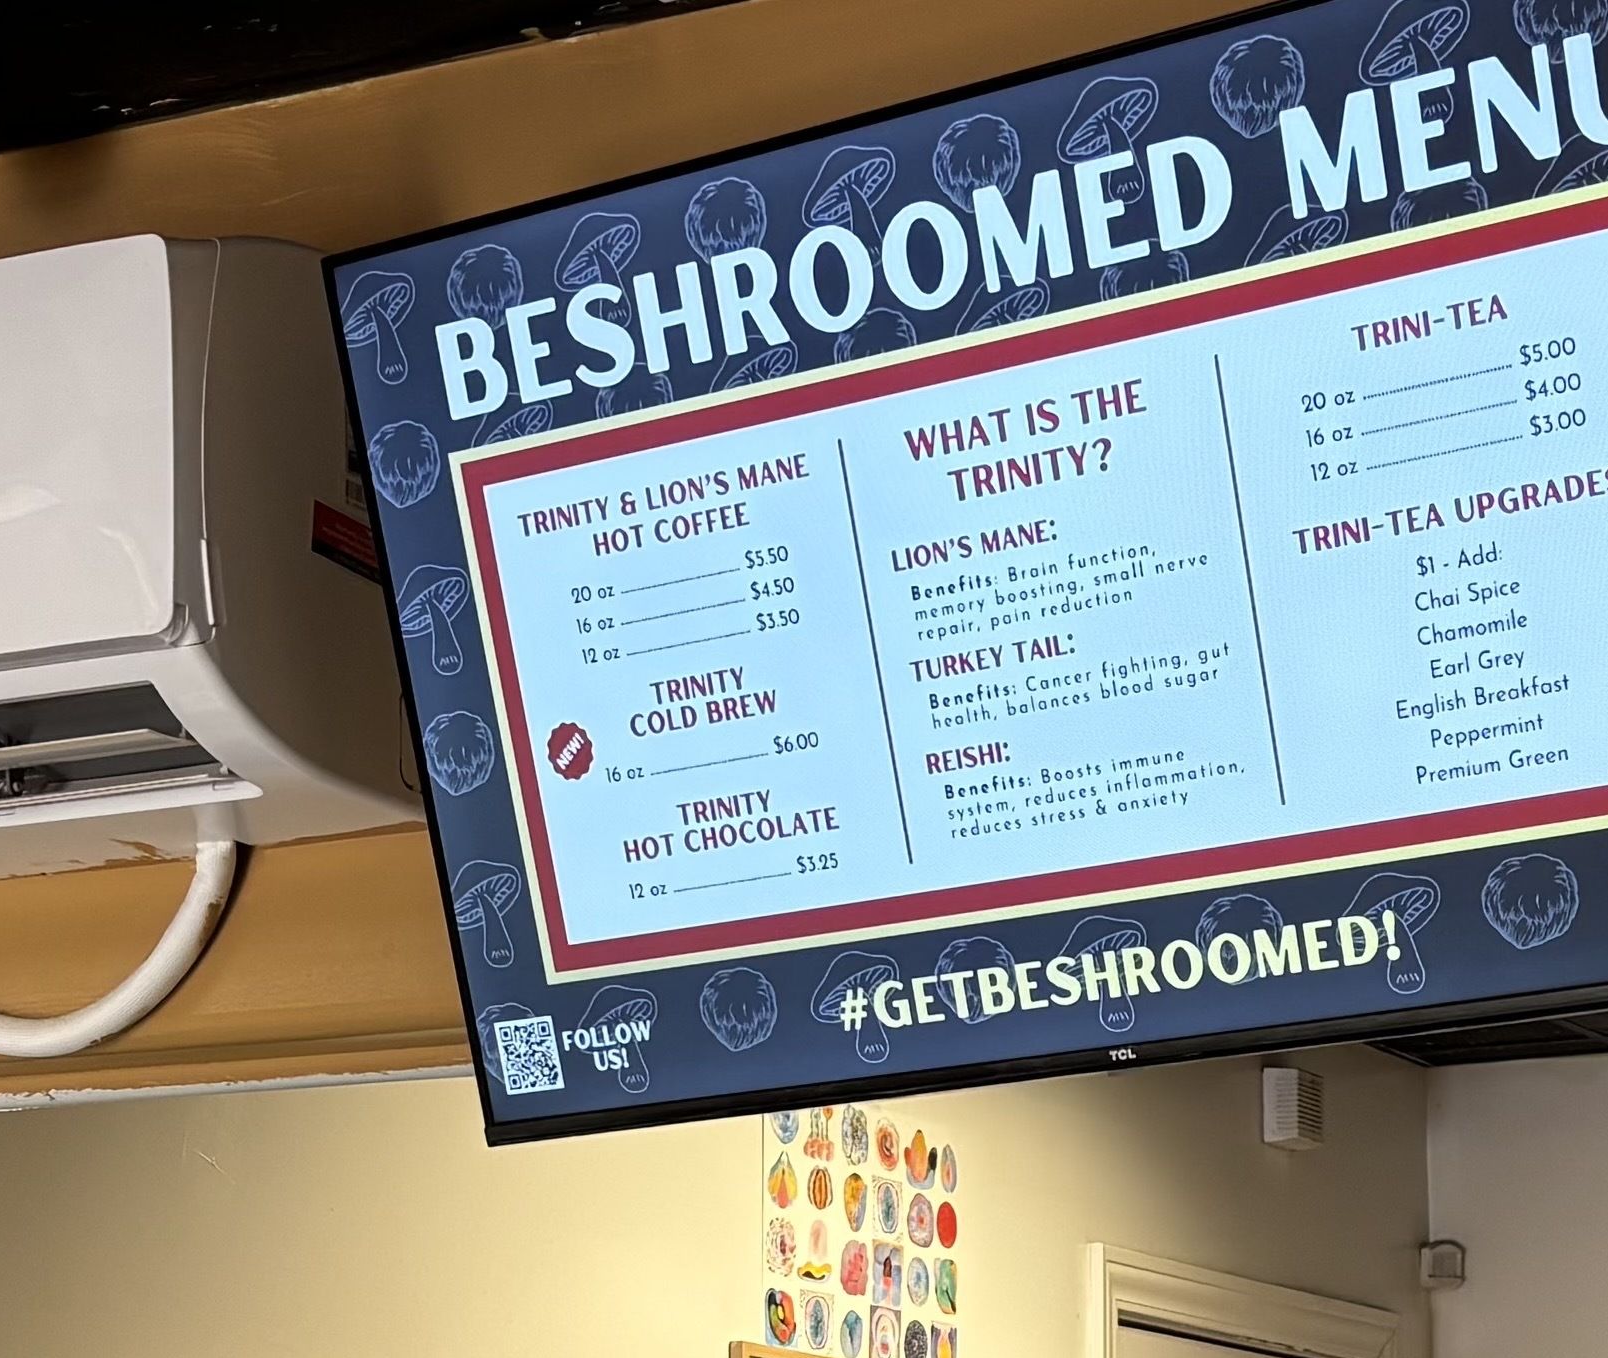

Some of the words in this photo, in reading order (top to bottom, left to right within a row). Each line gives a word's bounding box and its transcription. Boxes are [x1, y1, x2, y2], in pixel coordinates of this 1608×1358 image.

[434, 135, 1234, 422] BESHROOMED
[1350, 294, 1508, 351] TRINI-TEA
[1301, 391, 1327, 413] 20
[1334, 391, 1356, 406] oz
[1519, 336, 1576, 366] $5.00
[903, 408, 1011, 462] WHAT
[1025, 398, 1060, 436] IS
[1070, 378, 1147, 425] THE
[1305, 427, 1325, 448] 16
[1332, 426, 1354, 442] oz
[1524, 372, 1581, 402] $4.00
[947, 437, 1112, 501] TRINITY?
[1310, 461, 1331, 482] 12
[1337, 461, 1359, 477] oz
[1529, 408, 1586, 437] $3.00
[517, 495, 608, 537] TRINITY
[619, 491, 637, 516] &
[645, 470, 730, 511] LION'S
[736, 453, 810, 491] MANE
[592, 524, 644, 557] HOT
[654, 501, 750, 543] COFFEE
[891, 535, 973, 572] LION'S
[980, 519, 1057, 555] MANE:
[1291, 503, 1445, 555] TRINI-TEA
[570, 585, 592, 604] 20
[597, 585, 615, 599] oz
[744, 545, 789, 570] $5.50
[910, 574, 997, 601] Benefits:
[1007, 563, 1058, 582] Brain
[1068, 545, 1156, 569] function,
[1416, 555, 1435, 577] $1
[1457, 540, 1502, 569] Add:
[576, 617, 592, 634] 16
[597, 617, 615, 631] oz
[750, 576, 795, 601] $4.50
[915, 599, 985, 623] memory
[994, 581, 1084, 606] boosting,
[1093, 560, 1144, 586] small
[1155, 554, 1208, 575] nerve
[918, 619, 981, 641] repair,
[990, 610, 1031, 631] pain
[1040, 583, 1132, 618] reduction
[1414, 587, 1460, 611] Chai
[1467, 581, 1520, 605] Spice
[581, 647, 598, 665] 12
[603, 648, 621, 661] oz
[756, 608, 800, 632] $3.50
[1417, 608, 1528, 646] Chamomile
[908, 644, 1003, 682] TURKEY
[1011, 633, 1076, 663] TAIL:
[929, 683, 1017, 710] Benefits:
[1025, 671, 1091, 692] Cancer
[1102, 655, 1188, 679] fighting,
[1198, 642, 1229, 665] gut
[1430, 652, 1470, 679] Earl
[1478, 649, 1524, 670] Grey
[649, 666, 743, 705] TRINITY
[931, 704, 997, 729] health,
[1006, 690, 1090, 716] balances
[1099, 673, 1153, 699] blood
[1164, 669, 1218, 688] sugar
[1396, 689, 1467, 720] English
[1474, 674, 1569, 706] Breakfast
[629, 705, 698, 737] COLD
[705, 689, 776, 724] BREW
[1430, 713, 1544, 749] Peppermint
[556, 732, 584, 770] NEW!
[605, 766, 622, 783] 16
[626, 767, 645, 780] oz
[773, 731, 819, 755] $6.00
[925, 741, 1011, 775] REISHI:
[944, 775, 1032, 800] Benefits:
[1040, 763, 1102, 784] Boosts
[1112, 750, 1184, 772] immune
[1415, 760, 1501, 785] Premium
[1508, 749, 1569, 769] Green
[675, 789, 770, 826] TRINITY
[947, 801, 1016, 822] system,
[1025, 786, 1097, 808] reduces
[1106, 759, 1245, 794] inflammation,
[951, 818, 1022, 839] reduces
[1031, 808, 1086, 826] stress
[1095, 798, 1107, 816] &
[1117, 790, 1188, 812] anxiety
[623, 833, 674, 863] HOT
[684, 806, 840, 853] CHOCOLATE
[628, 882, 645, 900] 12
[650, 884, 668, 897] oz
[796, 852, 839, 874] $3.25
[840, 908, 1402, 1032] #GETBESHROOMED!
[562, 1019, 652, 1053] FOLLOW
[593, 1048, 629, 1071] US!
[1109, 1048, 1137, 1061] TCL
